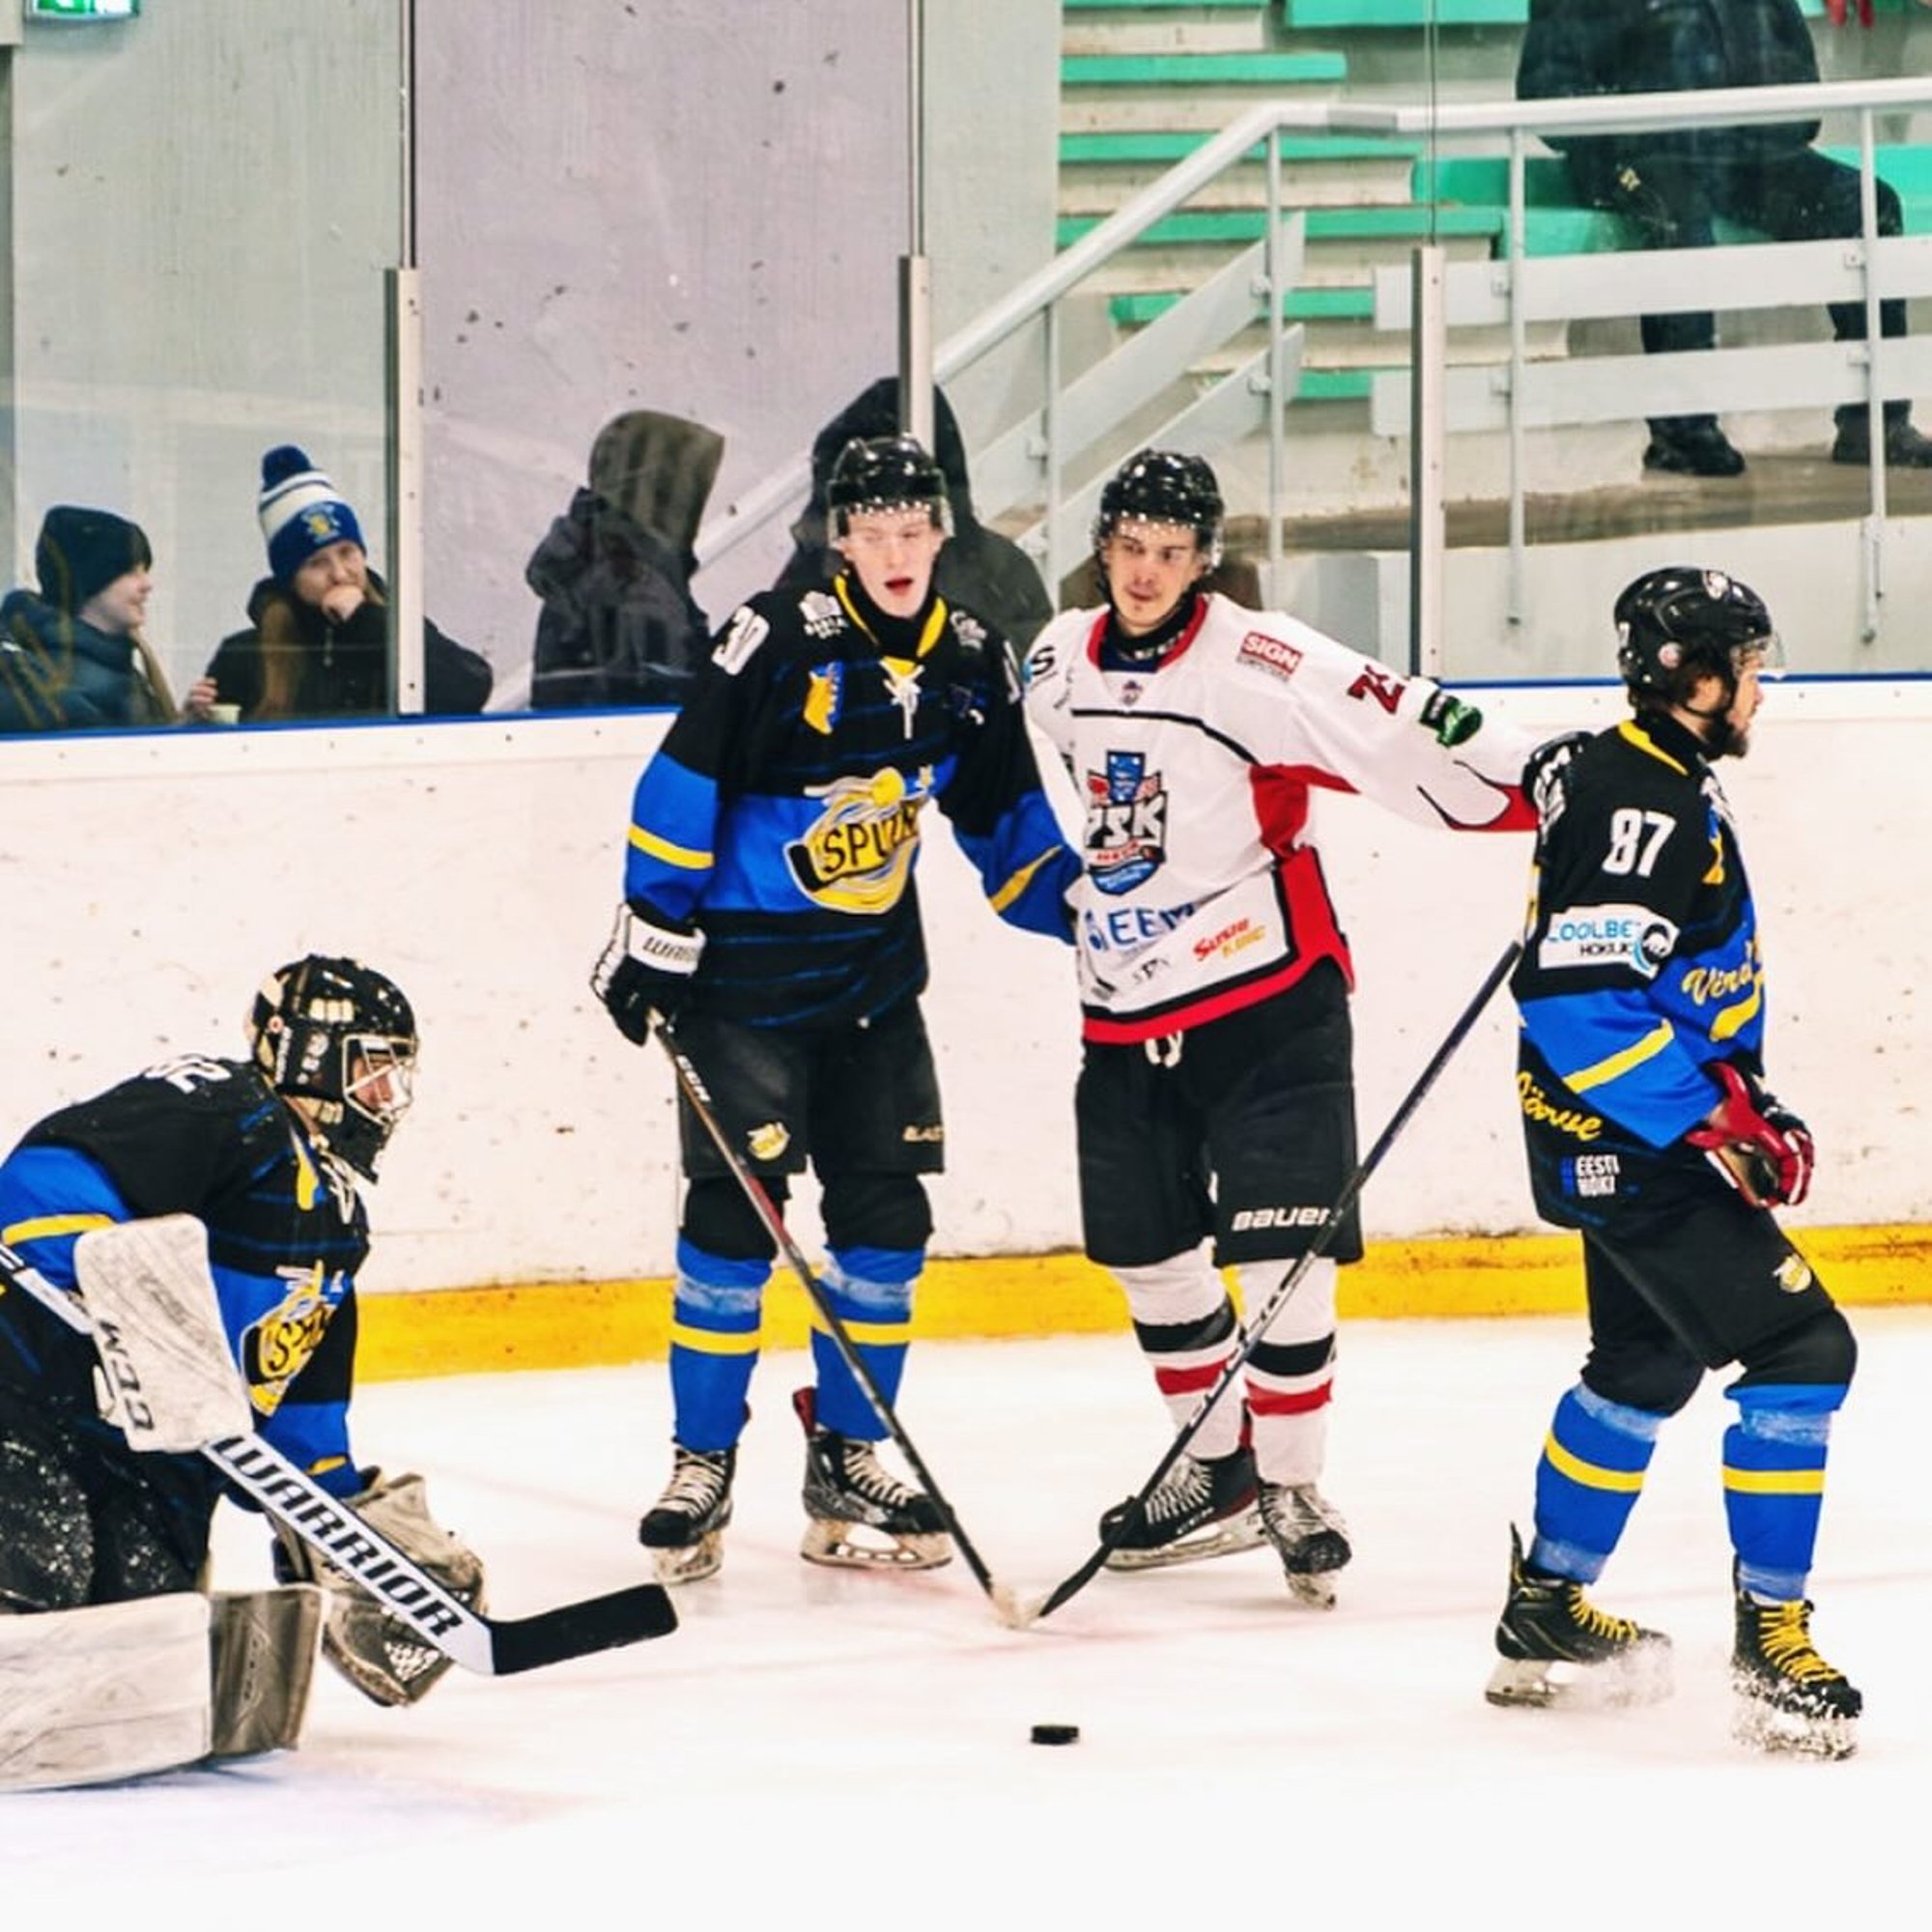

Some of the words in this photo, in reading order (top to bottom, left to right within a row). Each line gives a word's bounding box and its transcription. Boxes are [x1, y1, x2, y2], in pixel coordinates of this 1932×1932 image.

[711, 606, 770, 675] 30
[1242, 634, 1299, 668] SIGN
[1602, 808, 1678, 877] 87
[1576, 1154, 1620, 1176] EESTI
[99, 1318, 155, 1431] CCM
[211, 1435, 464, 1638] WARRIOR
